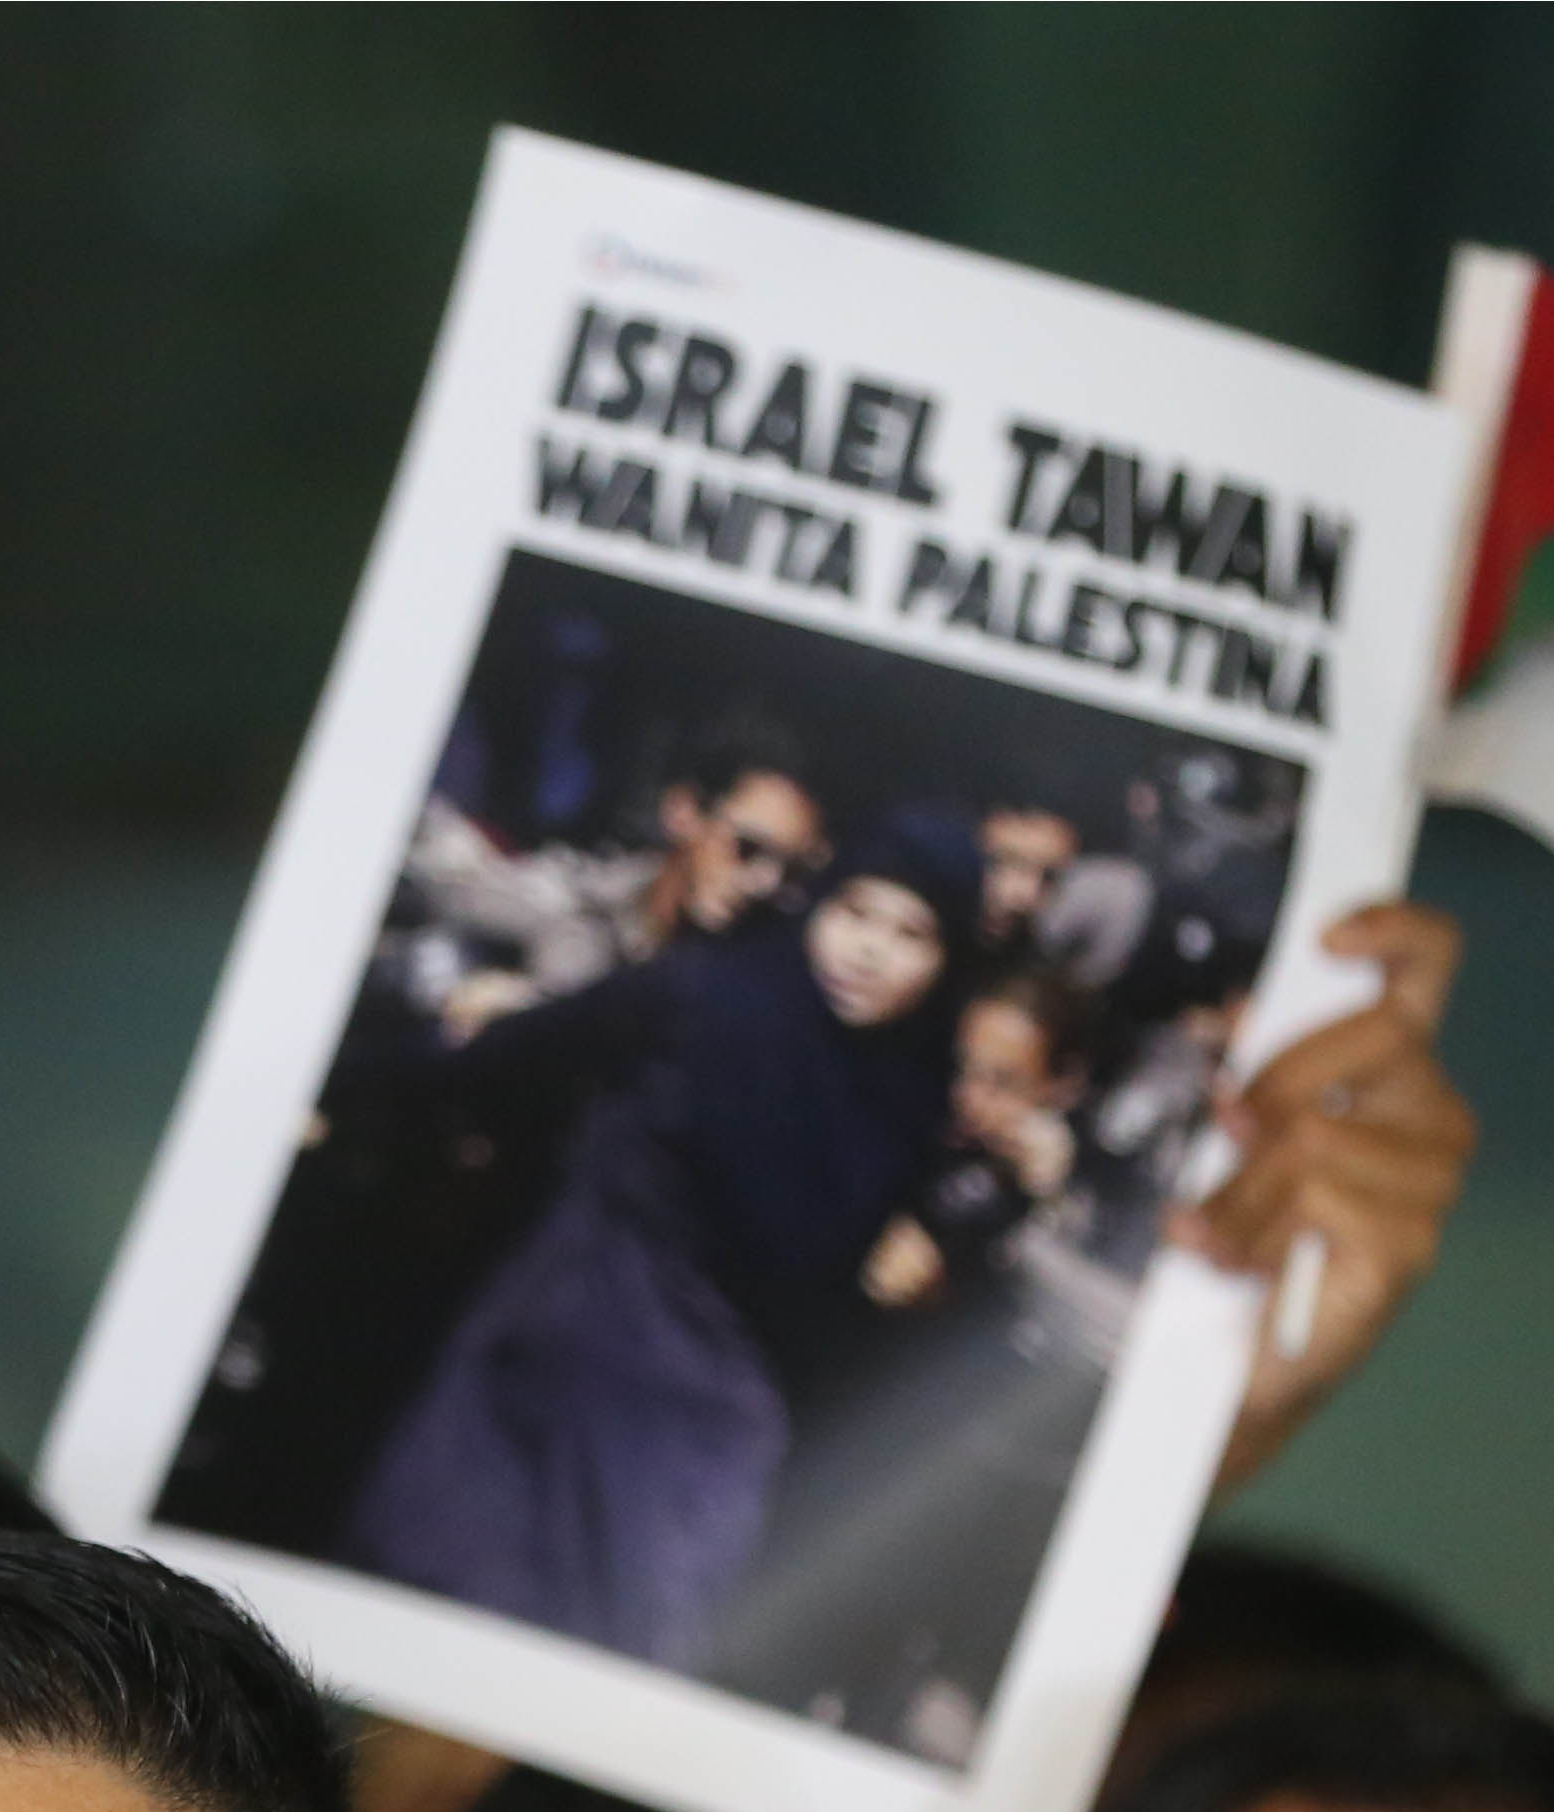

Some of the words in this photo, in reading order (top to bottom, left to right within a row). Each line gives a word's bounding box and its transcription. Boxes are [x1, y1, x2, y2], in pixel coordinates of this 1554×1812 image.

[533, 437, 860, 600] WANITA
[897, 535, 1332, 731] PALESTINA
[554, 303, 941, 510] ISRAEL
[1004, 418, 1354, 627] TAWAN
